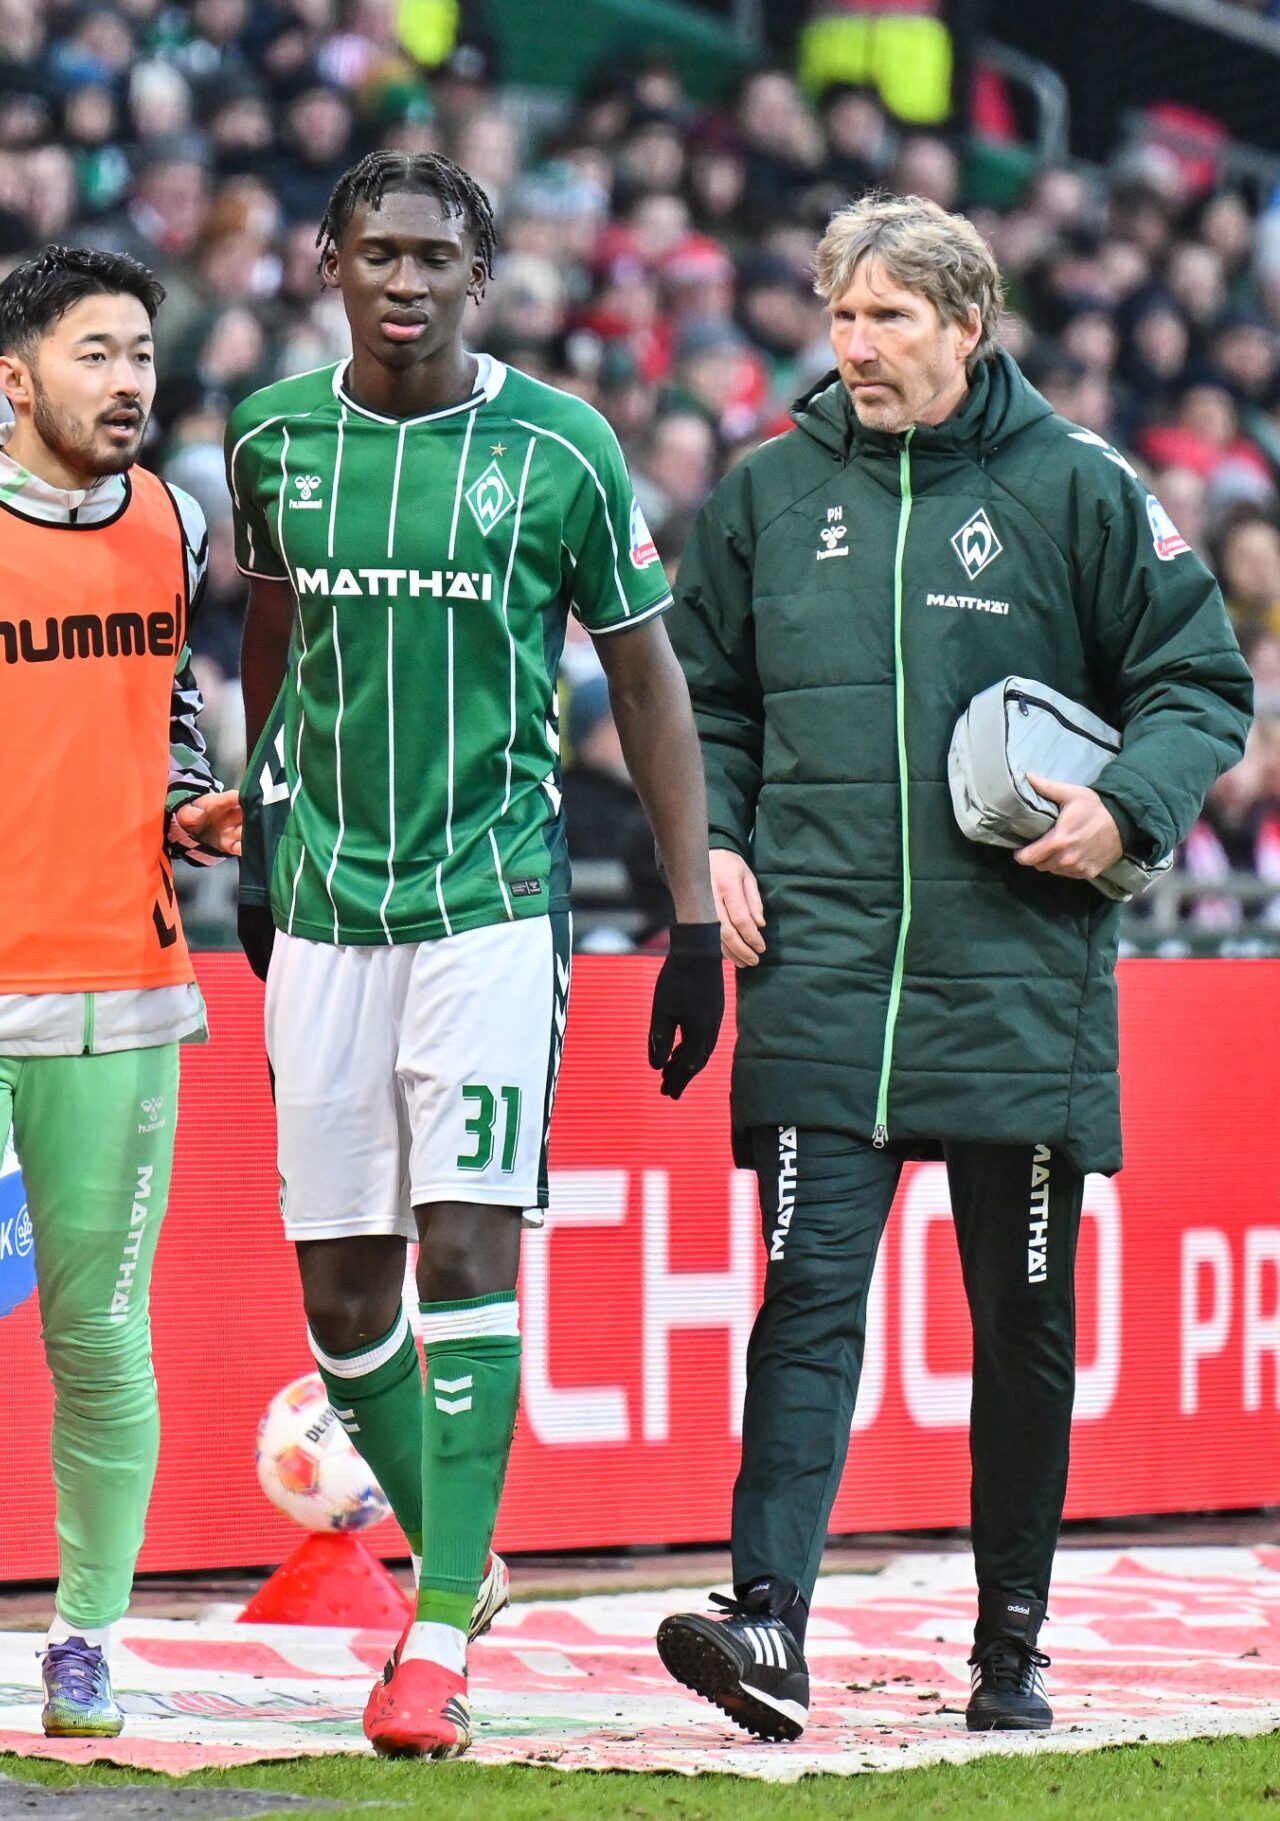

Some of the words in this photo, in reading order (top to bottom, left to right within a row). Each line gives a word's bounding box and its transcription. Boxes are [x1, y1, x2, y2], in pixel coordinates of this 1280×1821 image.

[295, 567, 493, 601] MATTHÄI
[456, 1084, 522, 1174] 31
[770, 1126, 798, 1261] MATTHÄ
